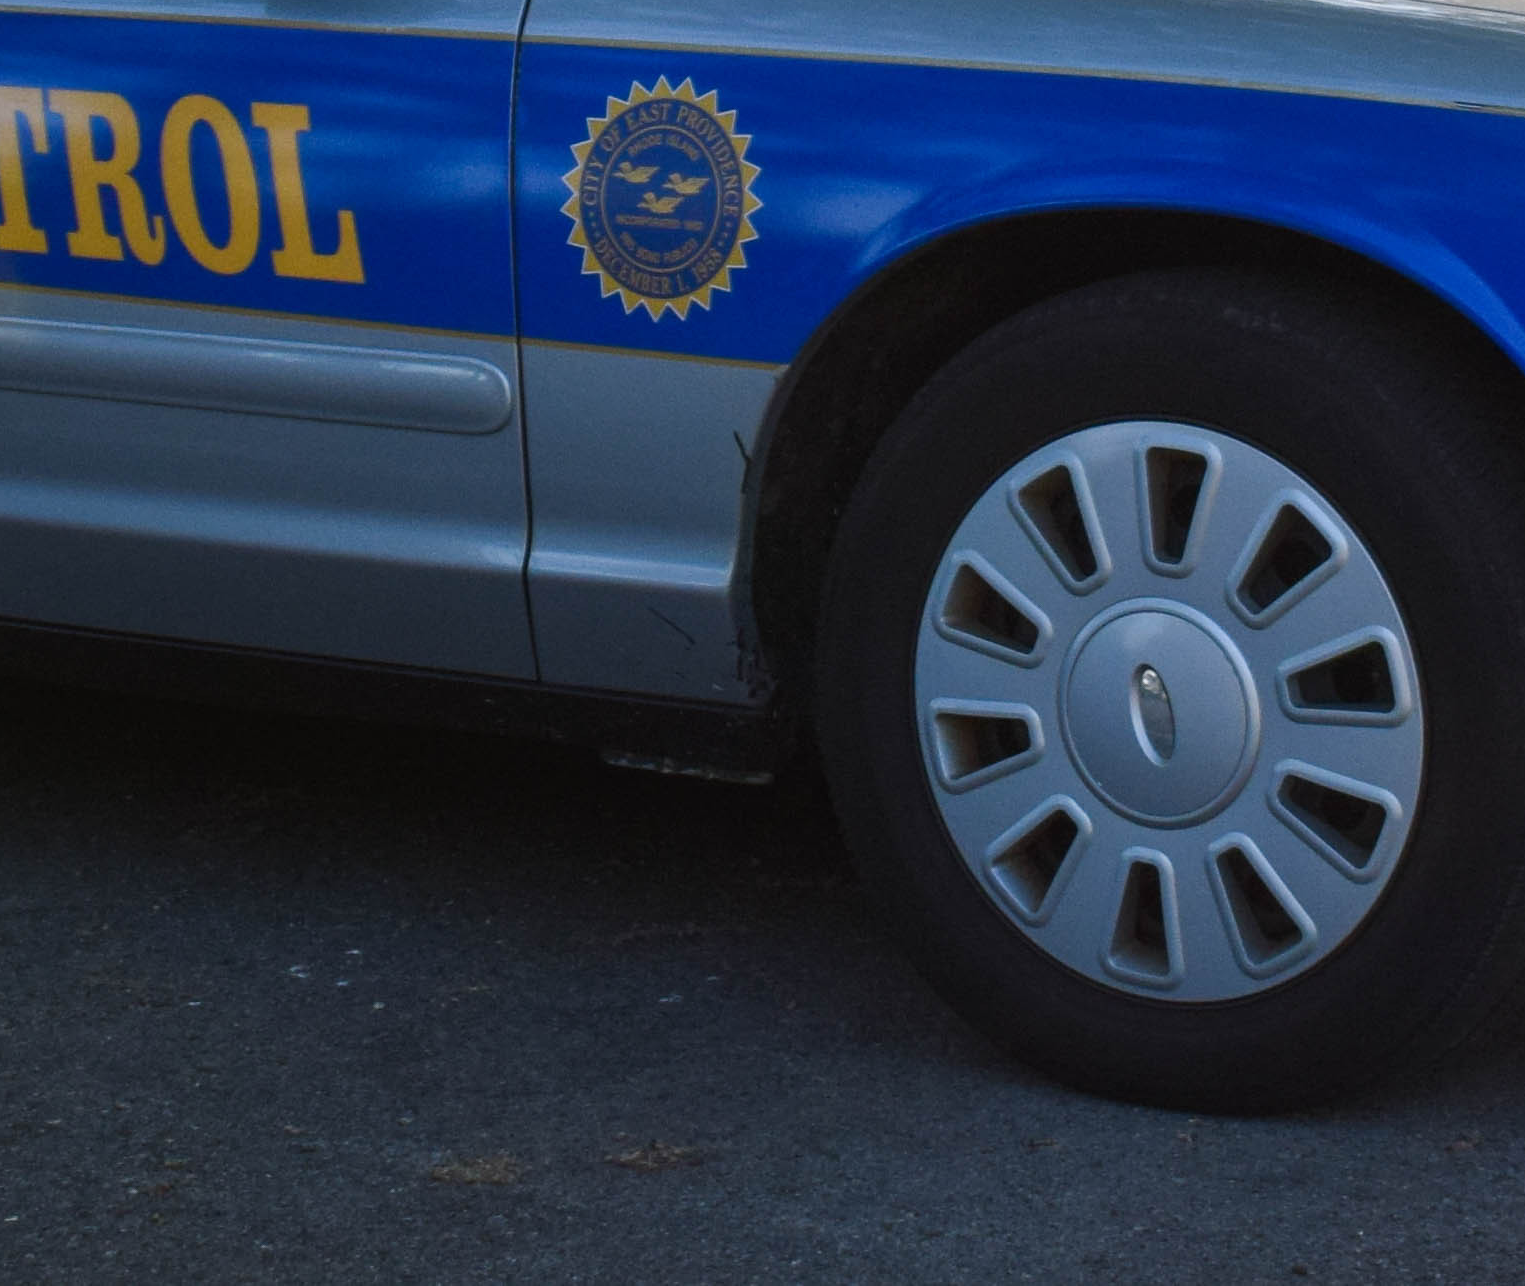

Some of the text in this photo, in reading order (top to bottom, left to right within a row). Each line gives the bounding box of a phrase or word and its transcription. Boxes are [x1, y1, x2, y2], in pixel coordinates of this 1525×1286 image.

[583, 103, 739, 216] CITY OF EAST PROVIDENCE
[595, 238, 671, 294] DECEMBER
